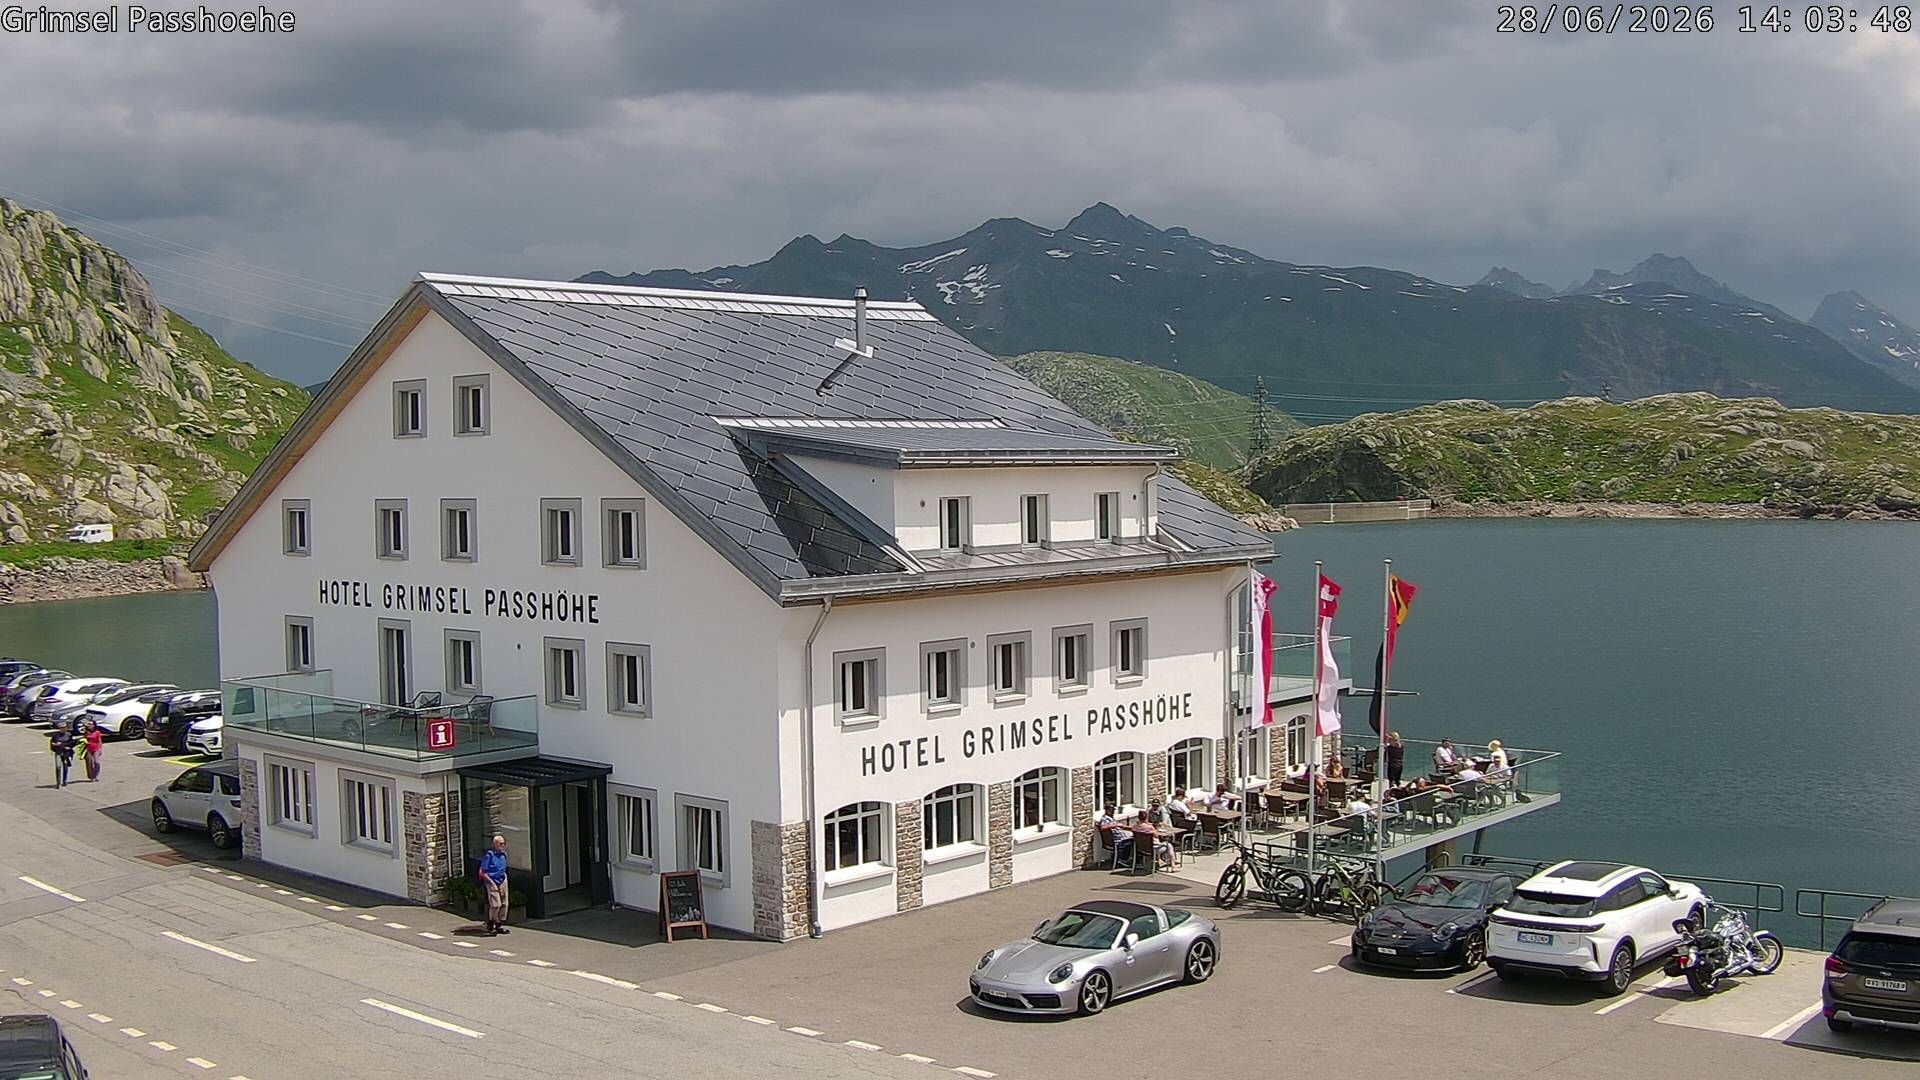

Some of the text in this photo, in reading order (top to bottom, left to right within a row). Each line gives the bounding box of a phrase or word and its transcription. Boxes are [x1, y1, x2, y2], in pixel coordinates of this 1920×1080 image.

[319, 579, 600, 624] HOTEL GRIMSEL PASSHÖHE
[862, 692, 1192, 777] HOTEL GRIMSEL PASSHÖHE
